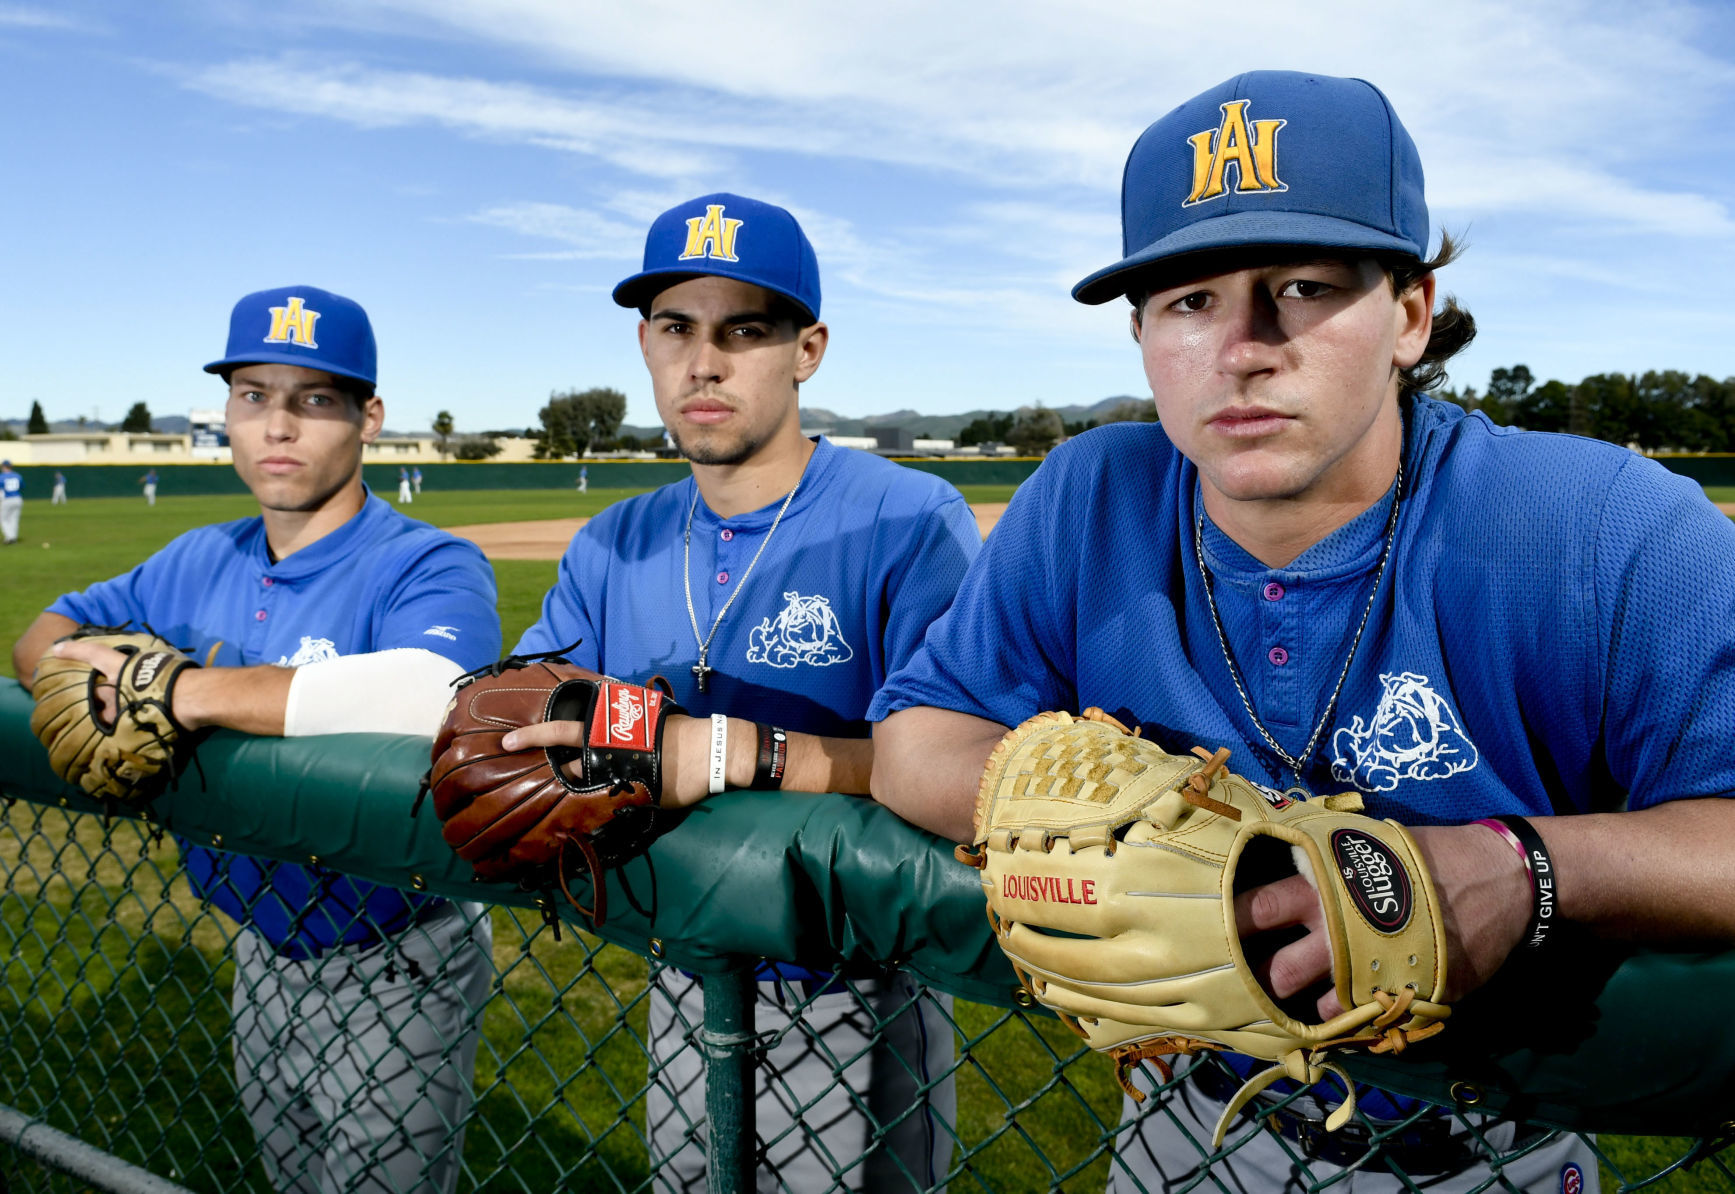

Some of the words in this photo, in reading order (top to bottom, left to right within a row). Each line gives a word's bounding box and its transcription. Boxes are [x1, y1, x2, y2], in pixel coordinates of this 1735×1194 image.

[611, 688, 640, 742] Rawlings
[1341, 842, 1375, 893] LOUISVILLE
[1346, 836, 1399, 914] Slugger
[1533, 850, 1550, 873] UP
[1003, 873, 1098, 905] LOUISVILLE
[1540, 878, 1553, 919] GIVE
